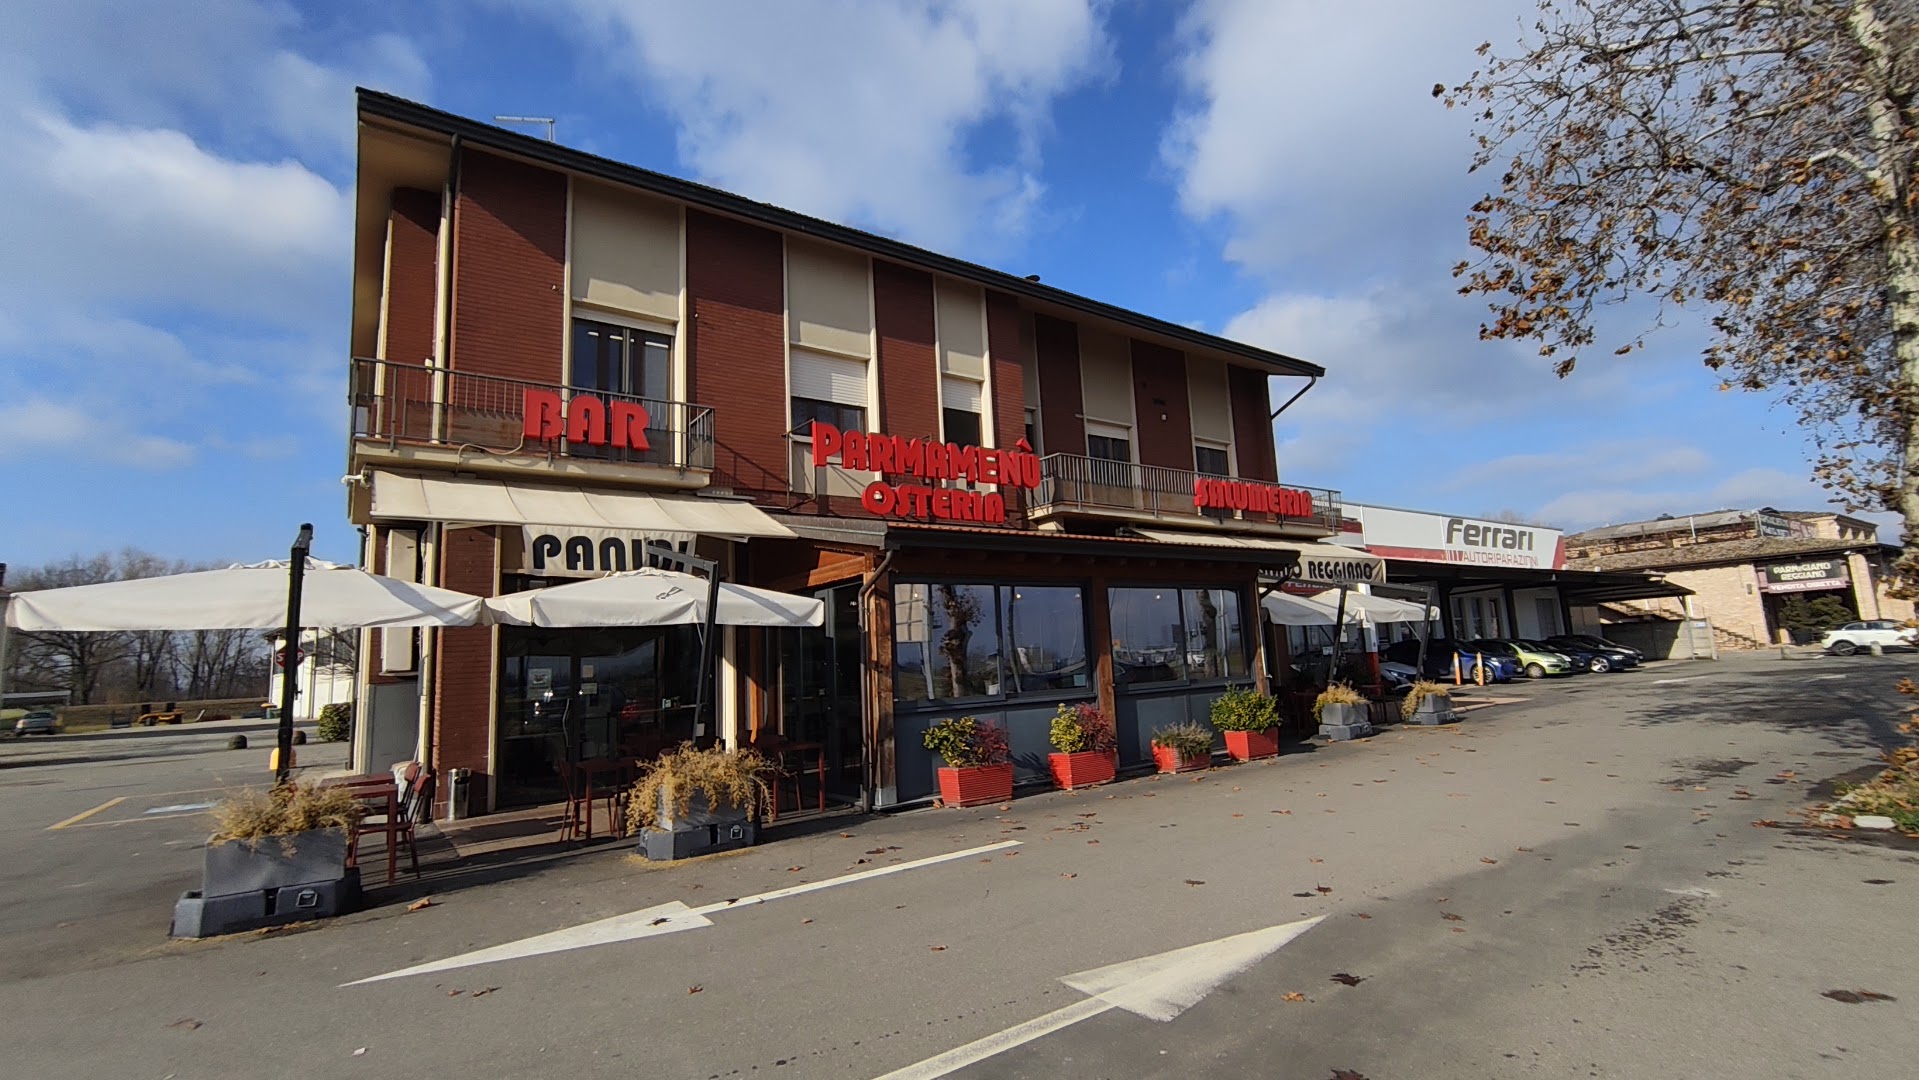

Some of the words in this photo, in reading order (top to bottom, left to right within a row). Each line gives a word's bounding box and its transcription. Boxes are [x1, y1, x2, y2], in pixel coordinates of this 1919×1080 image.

[523, 388, 650, 450] BAR
[812, 420, 1041, 489] PARMAMENÙ
[862, 481, 1005, 524] OSTERIA
[1194, 477, 1313, 518] SALUMERIA
[1446, 518, 1534, 551] Ferrari
[1308, 561, 1373, 580] REGGIANO
[1463, 551, 1539, 567] AUTORIPARAZIONI
[1773, 562, 1831, 574] PARMIGIANO
[1771, 583, 1806, 591] VENDITA
[1781, 570, 1826, 581] REGGIANO
